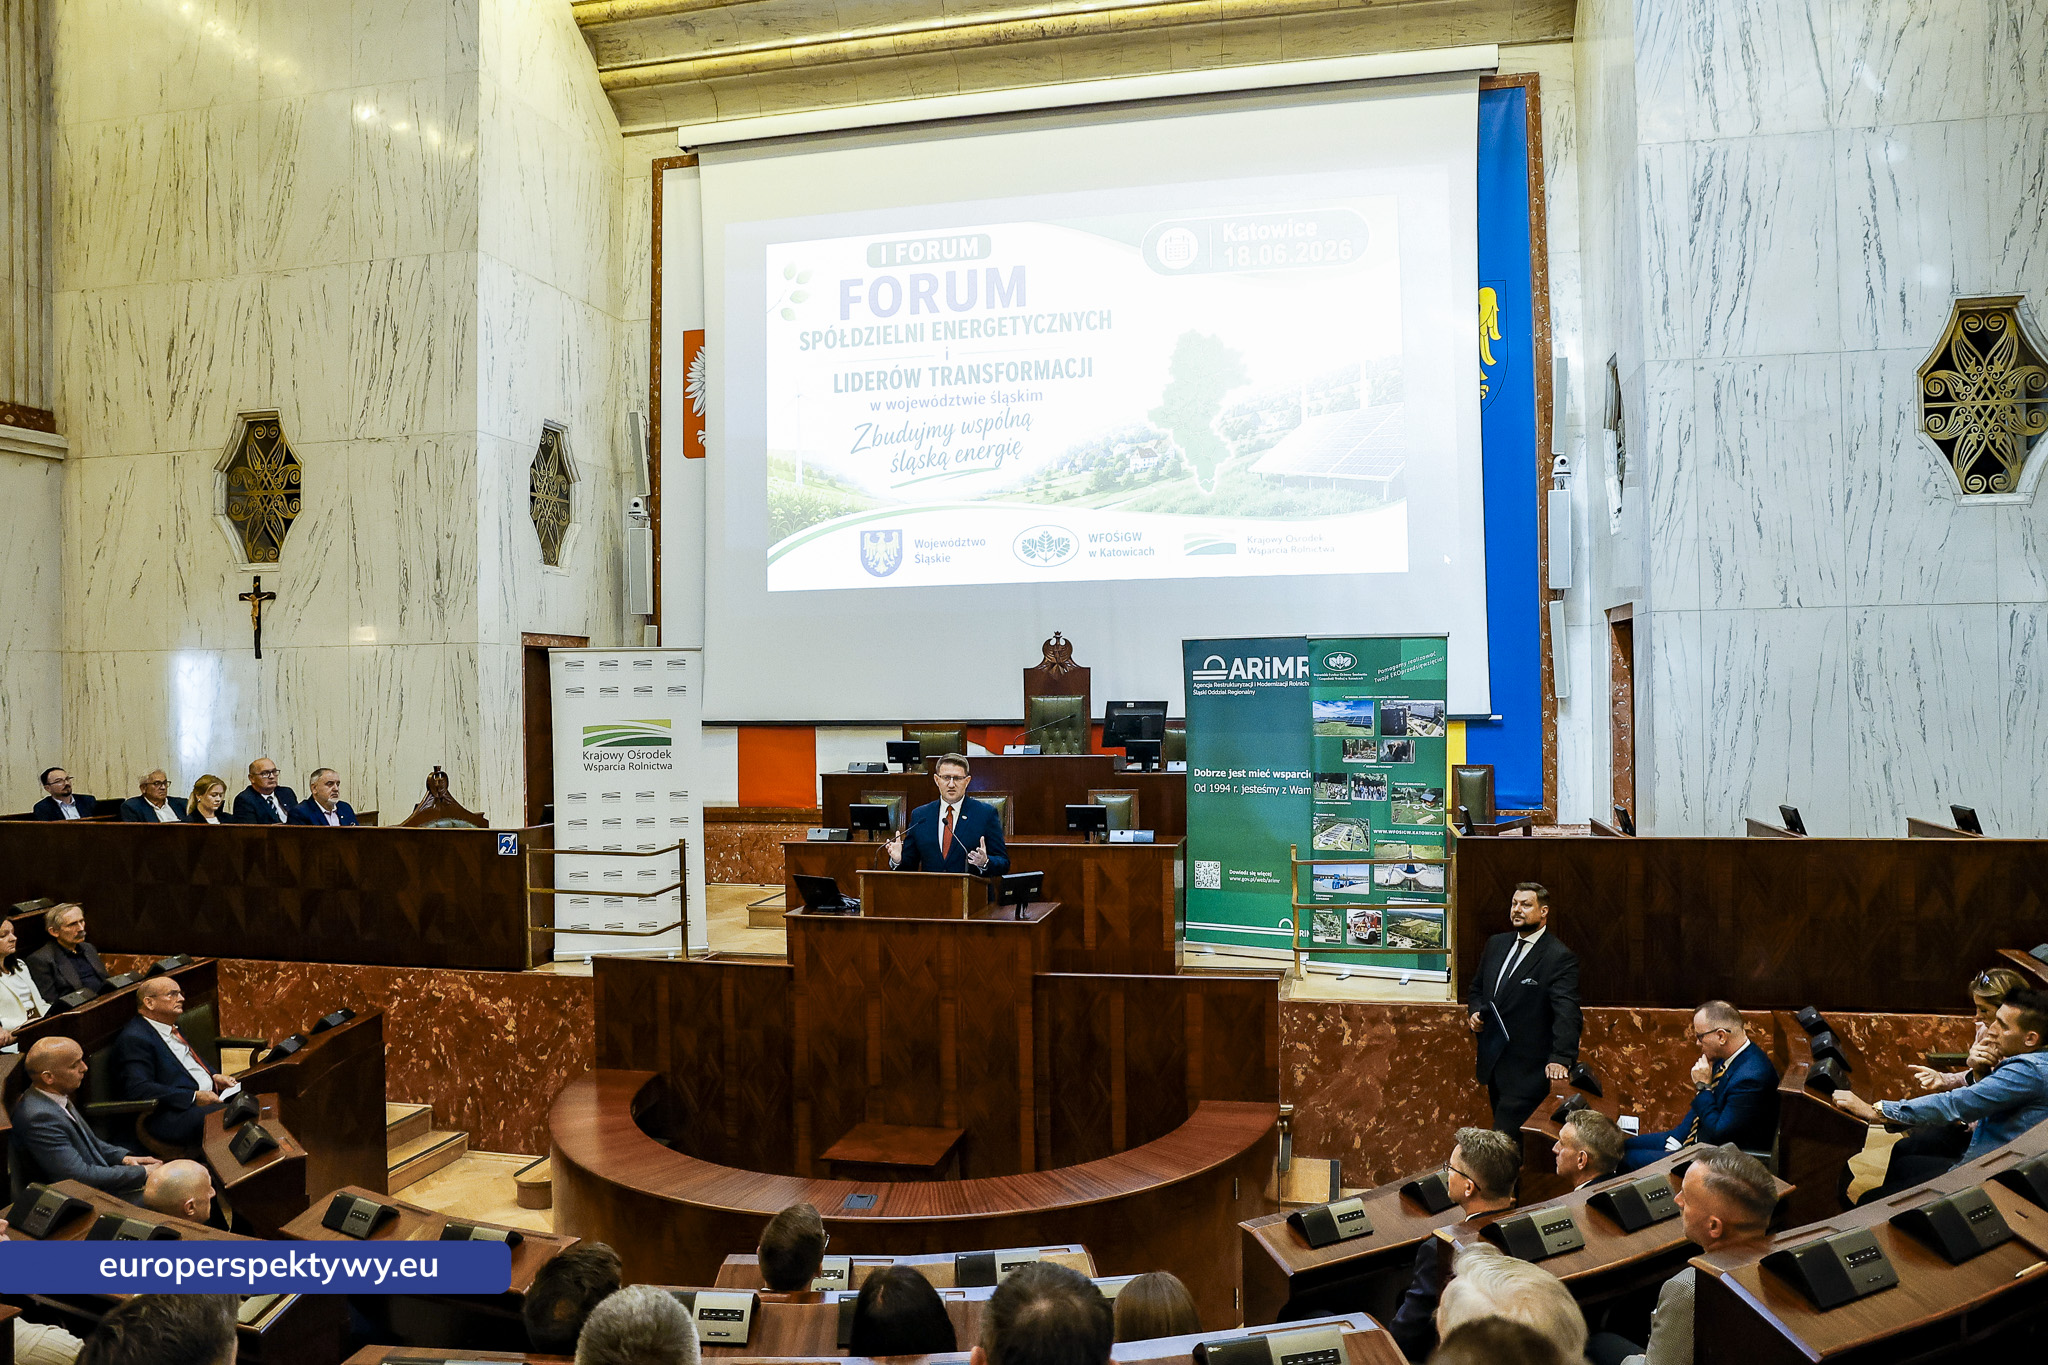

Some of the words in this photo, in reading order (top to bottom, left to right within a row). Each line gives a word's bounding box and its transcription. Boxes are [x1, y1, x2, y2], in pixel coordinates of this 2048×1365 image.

[1224, 219, 1317, 242] Katowice
[880, 244, 887, 265] I
[895, 237, 979, 263] FORUM
[1224, 240, 1353, 267] 18.06.2026
[839, 264, 1027, 321] FORUM
[799, 322, 925, 352] SPÓŁDZIELNI
[931, 309, 1113, 343] ENERGETYCZNYCH
[833, 365, 922, 394] LIDERÓW
[928, 356, 1093, 387] TRANSFORMACJI
[869, 400, 881, 412] w
[885, 393, 986, 413] województwie
[990, 389, 1043, 407] śląskim
[850, 420, 956, 455] Zbudujmy
[961, 407, 1034, 438] wspólną
[889, 444, 951, 477] śląską
[954, 438, 1024, 471] energię
[914, 536, 987, 550] Województwo
[1088, 529, 1143, 544] WFOŚiGW
[1246, 535, 1282, 547] Krajowy
[1088, 548, 1096, 557] w
[1098, 544, 1155, 558] Katowicach
[1246, 545, 1287, 557] Wsparcia
[1290, 542, 1336, 554] Rolnictwa
[914, 550, 951, 566] Śląskie
[1228, 655, 1310, 681] ARiMR
[1377, 661, 1407, 675] Pomagamy
[1227, 689, 1256, 697] Regionalny
[582, 750, 625, 763] Krajowy
[627, 748, 672, 761] Ośrodek
[583, 762, 626, 773] Wsparcia
[628, 760, 673, 772] Rolnictwa
[1193, 768, 1227, 778] Dobrze
[1227, 768, 1247, 780] jest
[1248, 768, 1271, 778] mieć
[1193, 783, 1206, 793] Od
[1209, 783, 1231, 793] 1994
[1240, 783, 1280, 796] jesteśmy
